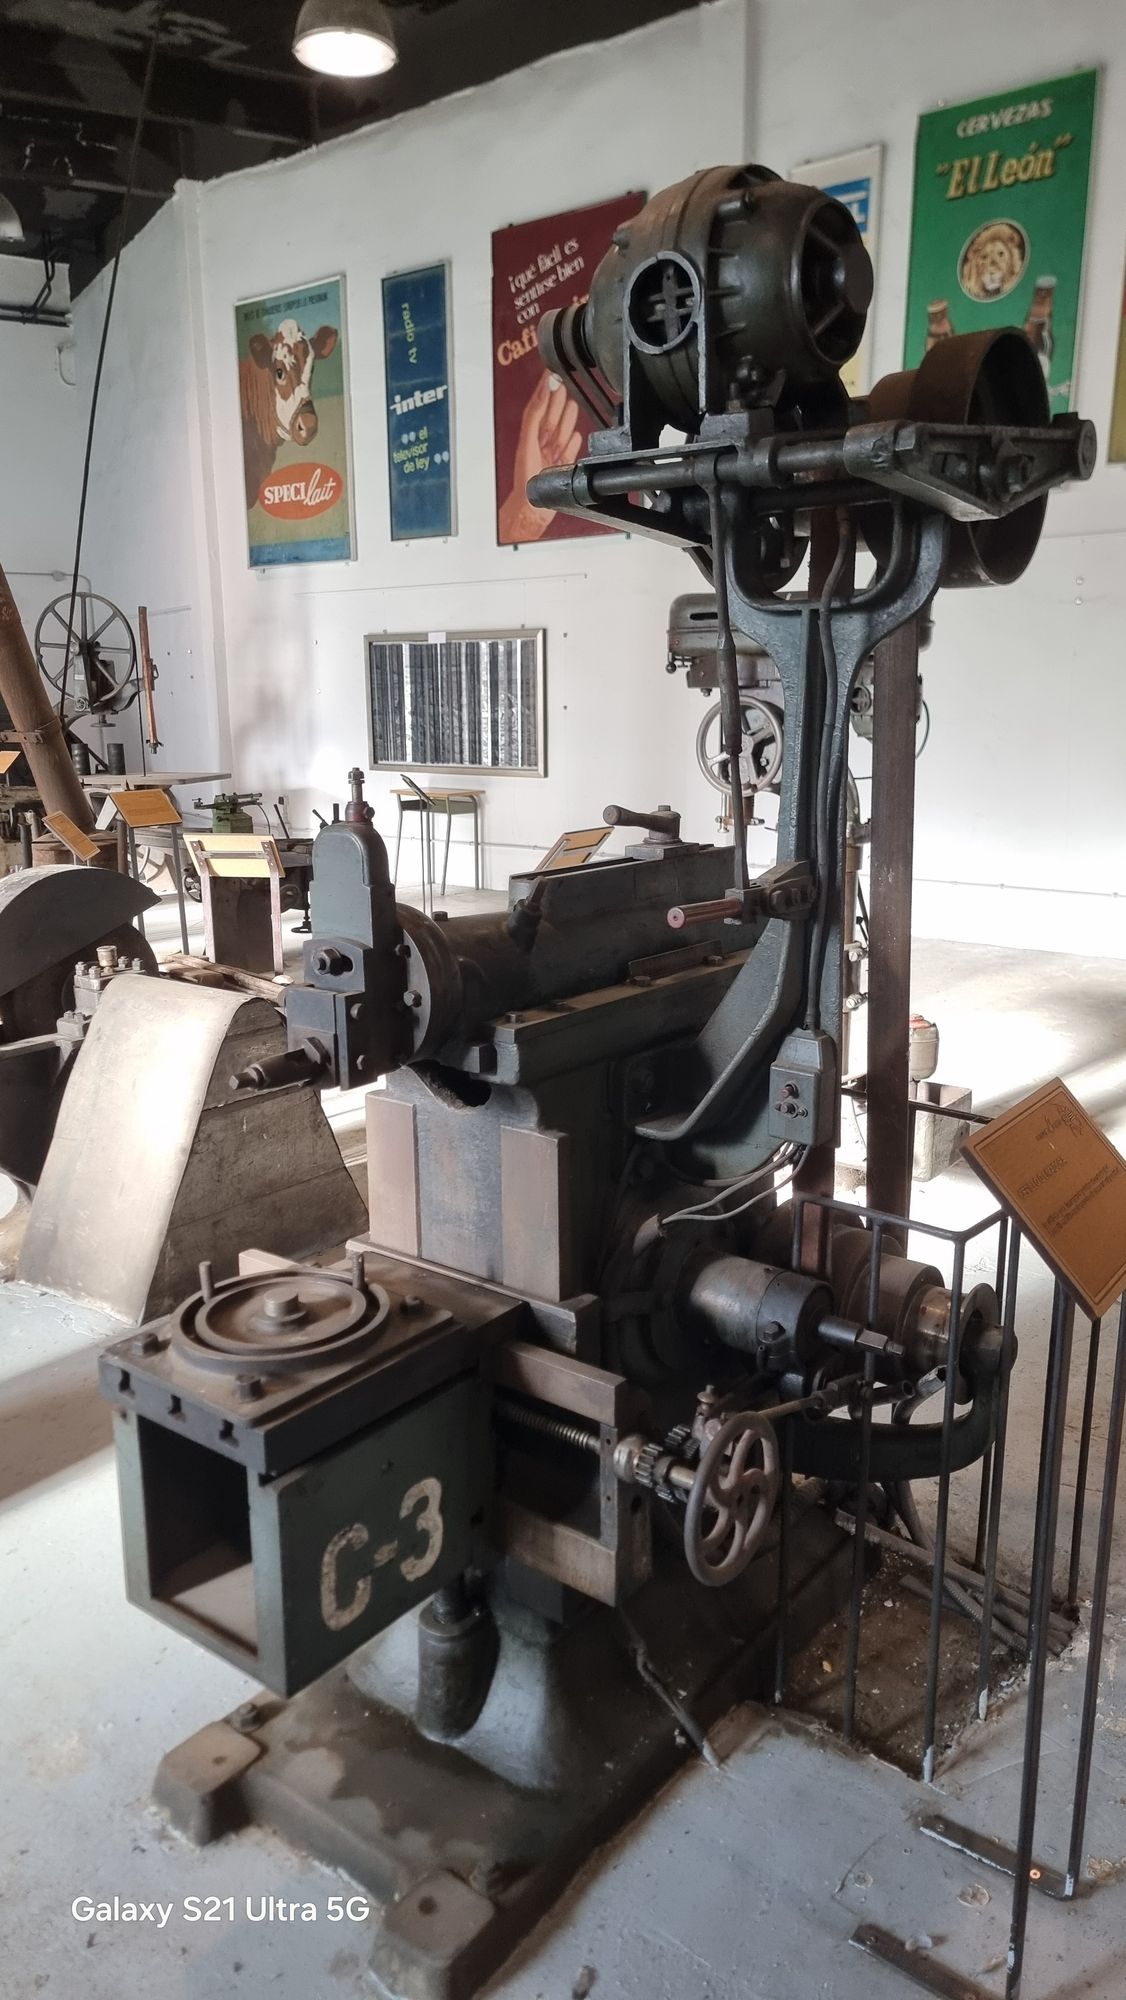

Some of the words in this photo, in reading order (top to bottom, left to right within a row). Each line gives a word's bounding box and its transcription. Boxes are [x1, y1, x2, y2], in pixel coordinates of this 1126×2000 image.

[956, 97, 1053, 139] CERVEZAS
[563, 237, 580, 255] es
[556, 255, 585, 282] bien
[401, 303, 416, 342] radio
[516, 302, 540, 325] con
[408, 346, 418, 364] tv
[390, 384, 448, 416] inter
[393, 443, 429, 464] televisor
[403, 461, 416, 474] de
[415, 456, 430, 472] ley
[321, 1476, 444, 1632] C-3
